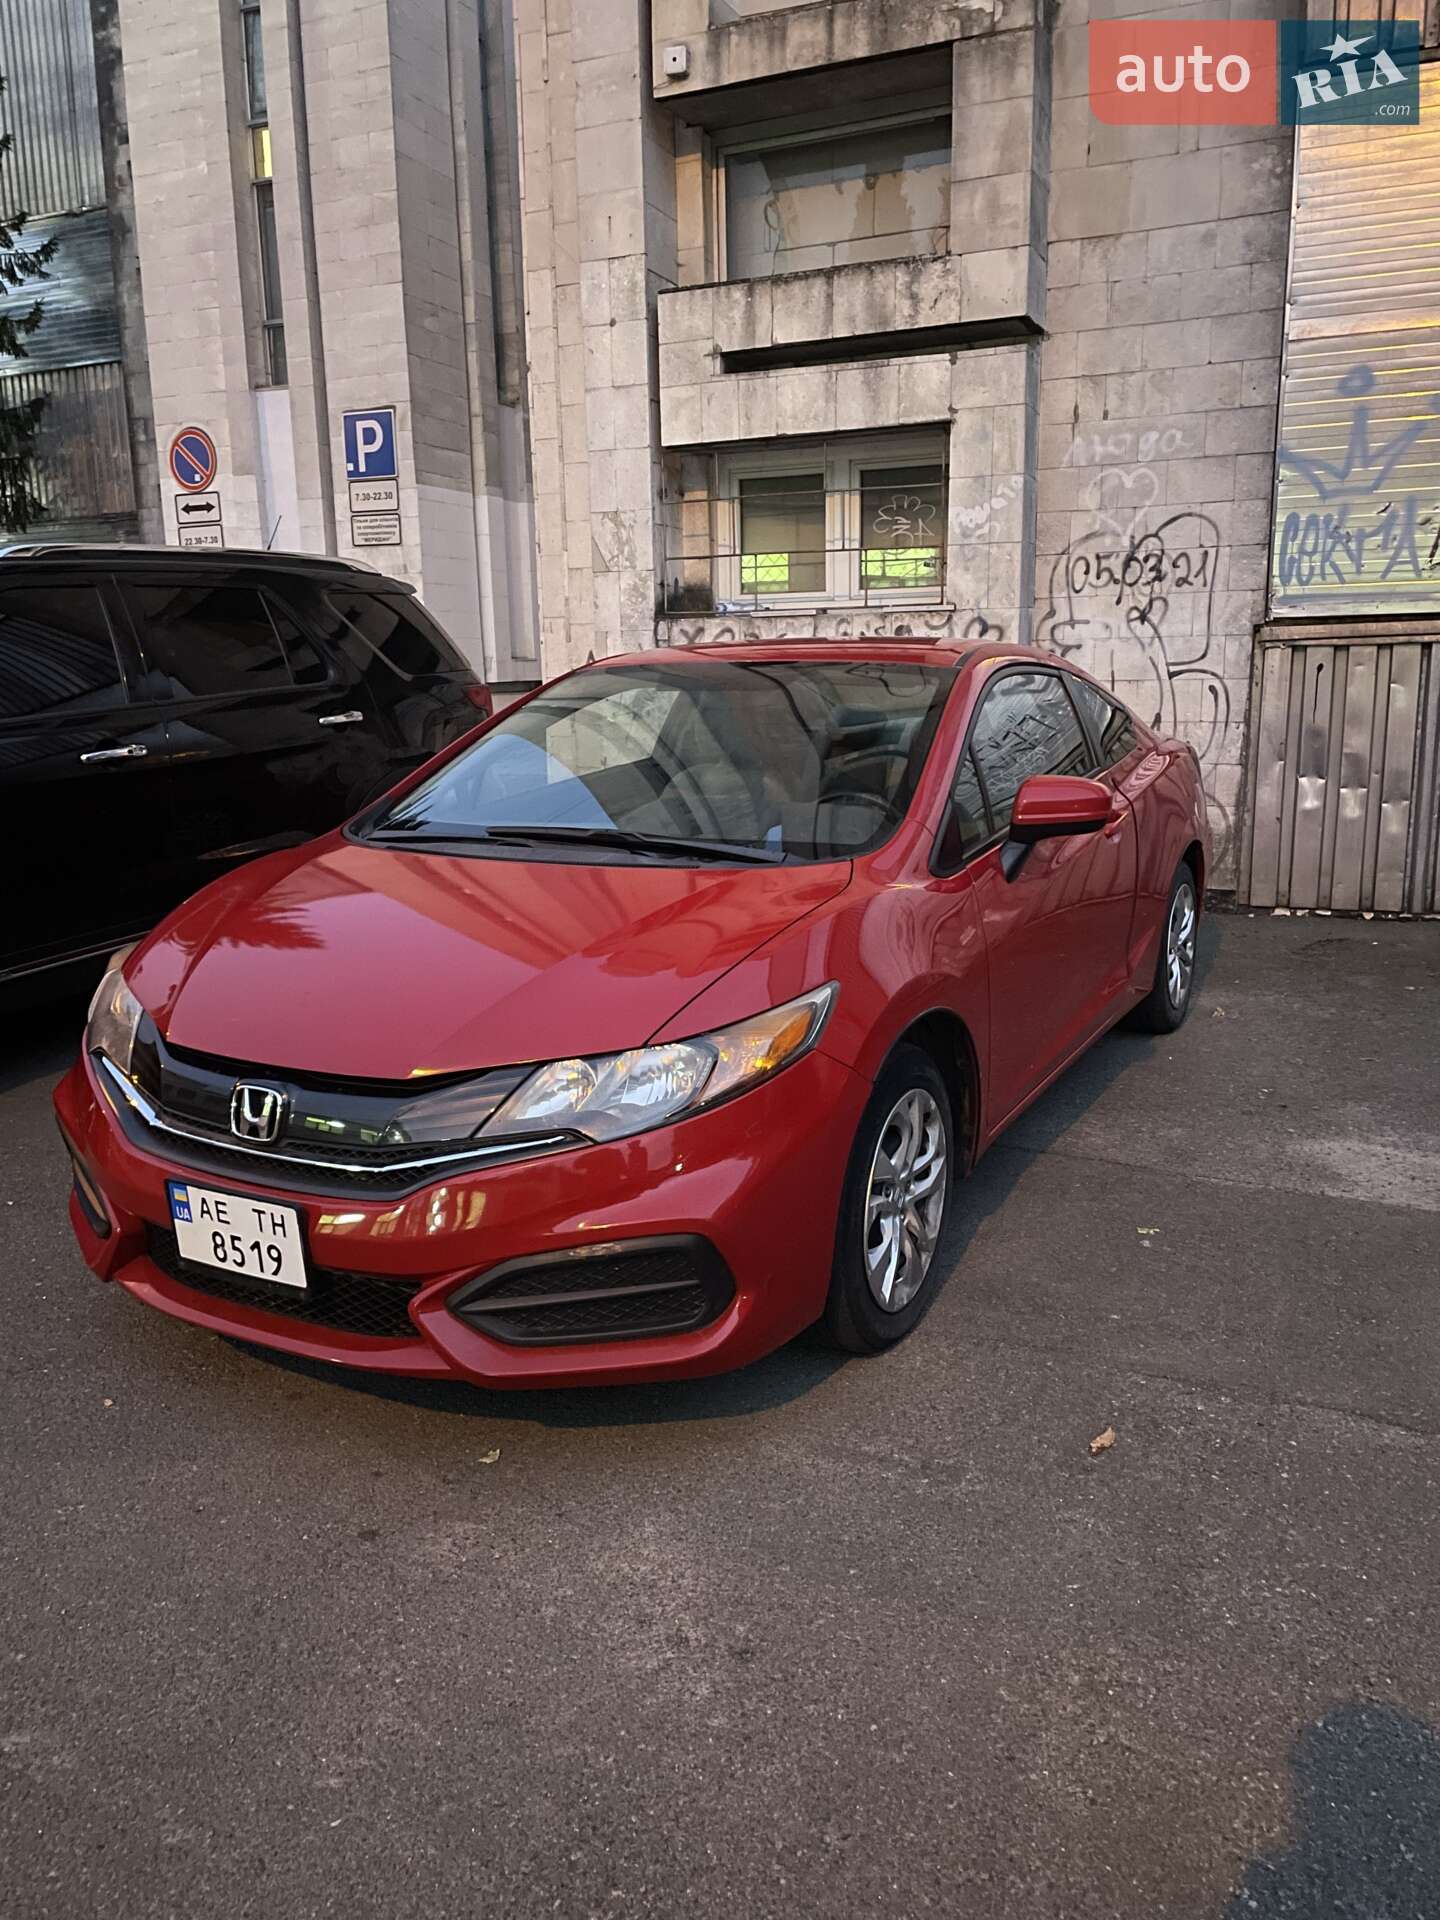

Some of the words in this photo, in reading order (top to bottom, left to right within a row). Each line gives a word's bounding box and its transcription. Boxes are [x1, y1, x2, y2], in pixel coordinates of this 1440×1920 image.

[356, 419, 384, 473] P
[355, 490, 393, 502] 7.30-22.30
[176, 1206, 191, 1221] UA
[200, 1197, 231, 1225] AE
[252, 1208, 287, 1238] TH
[212, 1231, 283, 1276] 8519
